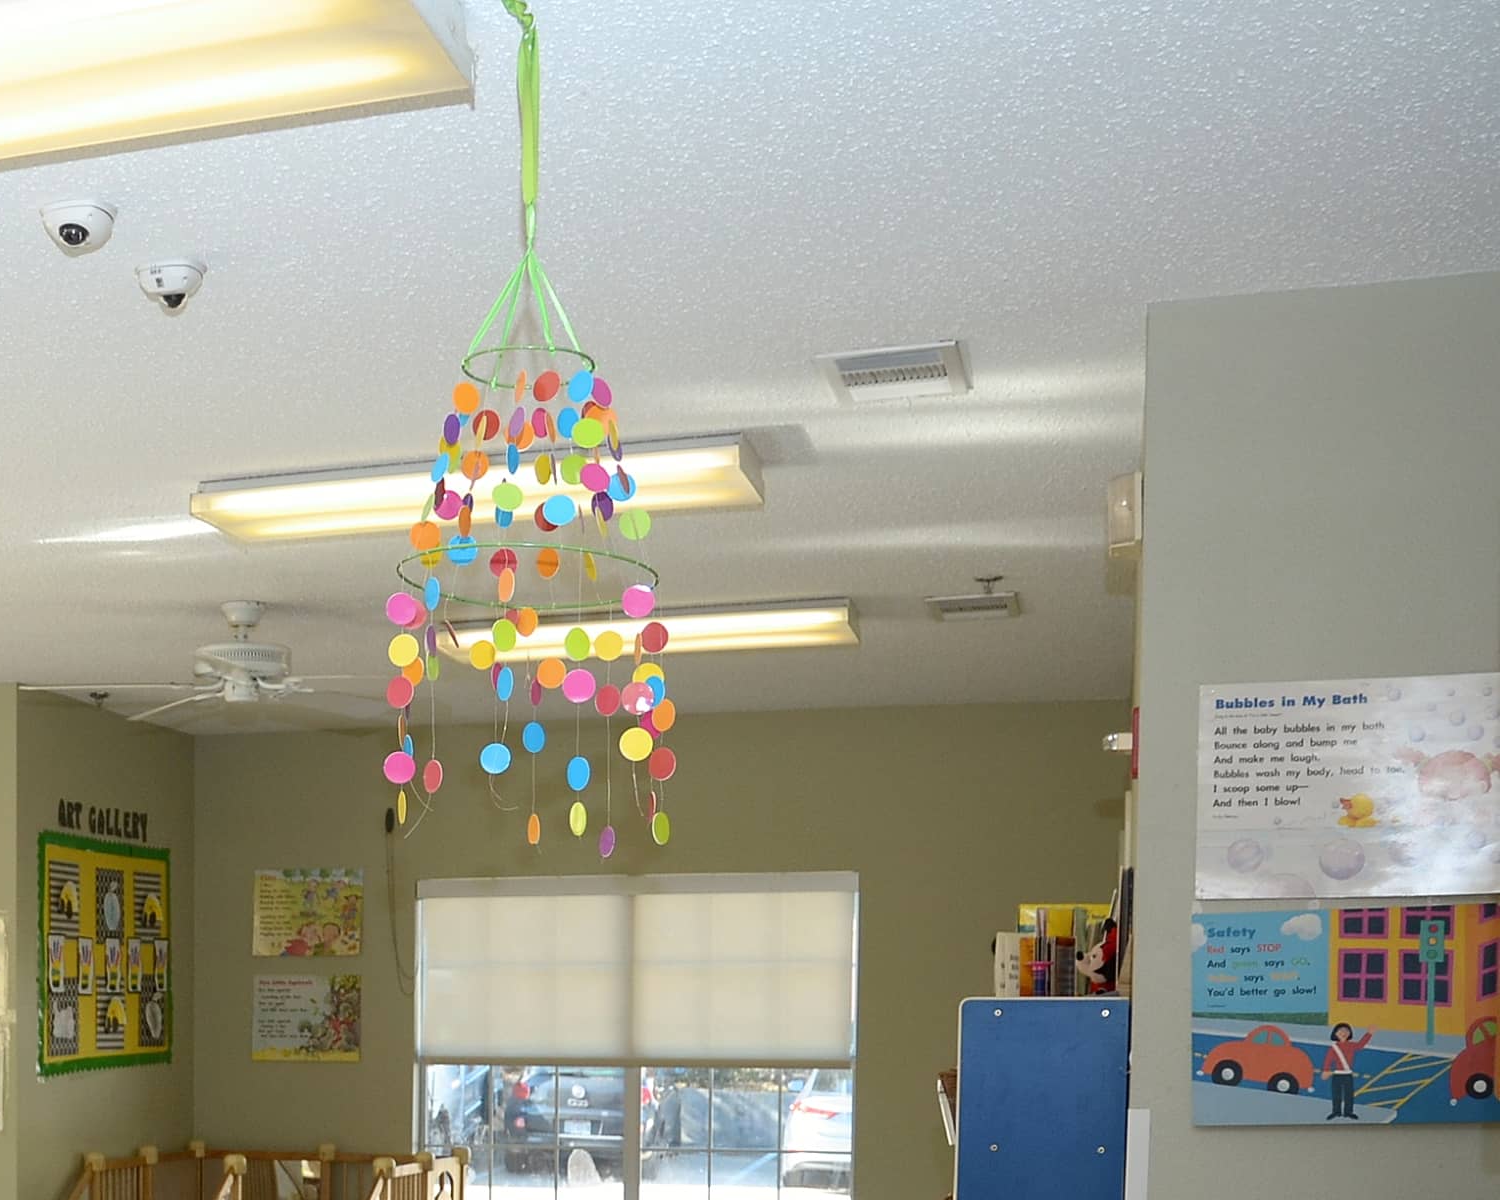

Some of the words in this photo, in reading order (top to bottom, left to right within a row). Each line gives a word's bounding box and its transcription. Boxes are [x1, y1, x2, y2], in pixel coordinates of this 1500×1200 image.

[1215, 696, 1275, 710] Bubbles
[1281, 696, 1296, 707] in
[1302, 695, 1326, 708] My
[1332, 693, 1368, 705] Bath
[1214, 726, 1228, 736] All
[1233, 725, 1247, 735] the
[1253, 725, 1277, 736] baby
[1283, 724, 1320, 733] bubbles
[1326, 723, 1335, 732] in
[1341, 724, 1356, 733] my
[1362, 721, 1385, 730] bath
[1214, 741, 1247, 750] Bounce
[1253, 740, 1280, 751] along
[1285, 739, 1304, 748] and
[1310, 738, 1337, 748] bump
[1213, 755, 1233, 764] And
[1239, 755, 1264, 763] make
[1291, 753, 1321, 764] laugh.
[1213, 770, 1249, 779] Bubbles
[1255, 768, 1280, 777] wash
[1286, 769, 1301, 778] my
[1307, 767, 1334, 778] body,
[1339, 766, 1364, 776] head
[1213, 785, 1217, 793] I
[1223, 785, 1250, 794] scoop
[1255, 784, 1280, 792] some
[1212, 799, 1232, 808] And
[1238, 798, 1258, 807] then
[1264, 798, 1268, 806] I
[1274, 797, 1301, 806] blow!
[58, 798, 83, 830] ART
[89, 806, 148, 843] GALLERY
[1207, 926, 1256, 939] Safety
[1207, 945, 1225, 954] Red
[1230, 946, 1250, 955] says
[1206, 960, 1227, 968] And
[1264, 959, 1285, 968] says
[1243, 975, 1264, 984] says
[1207, 987, 1234, 997] You'd
[1240, 987, 1268, 997] better
[1273, 988, 1286, 997] go
[1292, 985, 1317, 995] slow!
